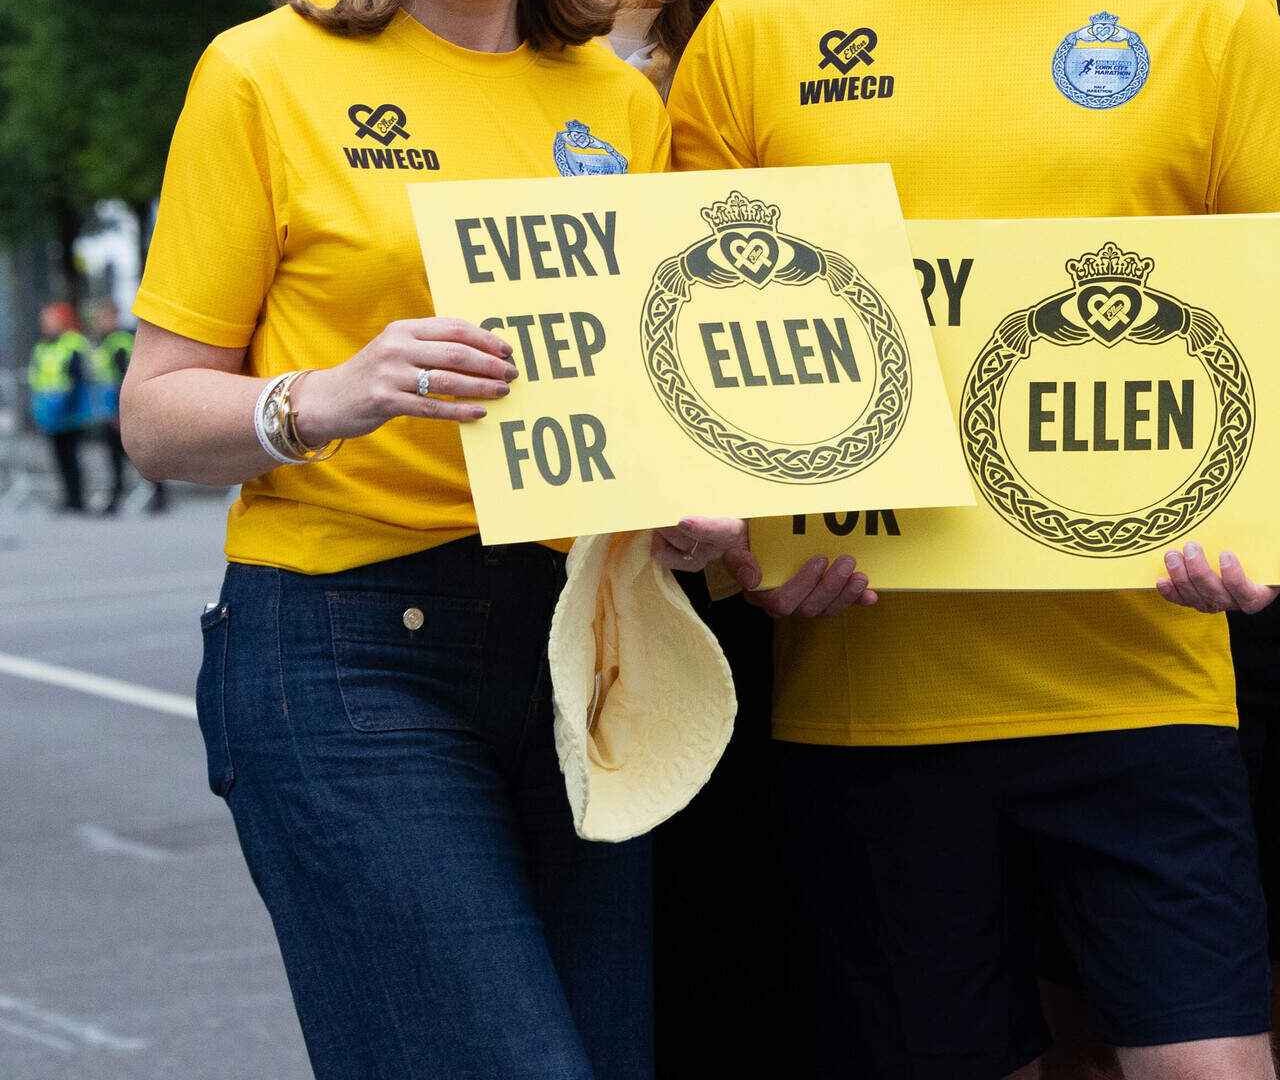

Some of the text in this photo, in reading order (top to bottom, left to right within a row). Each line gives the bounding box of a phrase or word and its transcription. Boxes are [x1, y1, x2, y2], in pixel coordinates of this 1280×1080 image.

[800, 75, 895, 106] WWECD
[343, 147, 440, 170] WWECD
[455, 211, 620, 283] EVERY
[699, 318, 861, 388] ELLEN
[1029, 380, 1194, 452] ELLEN
[500, 414, 615, 490] FOR
